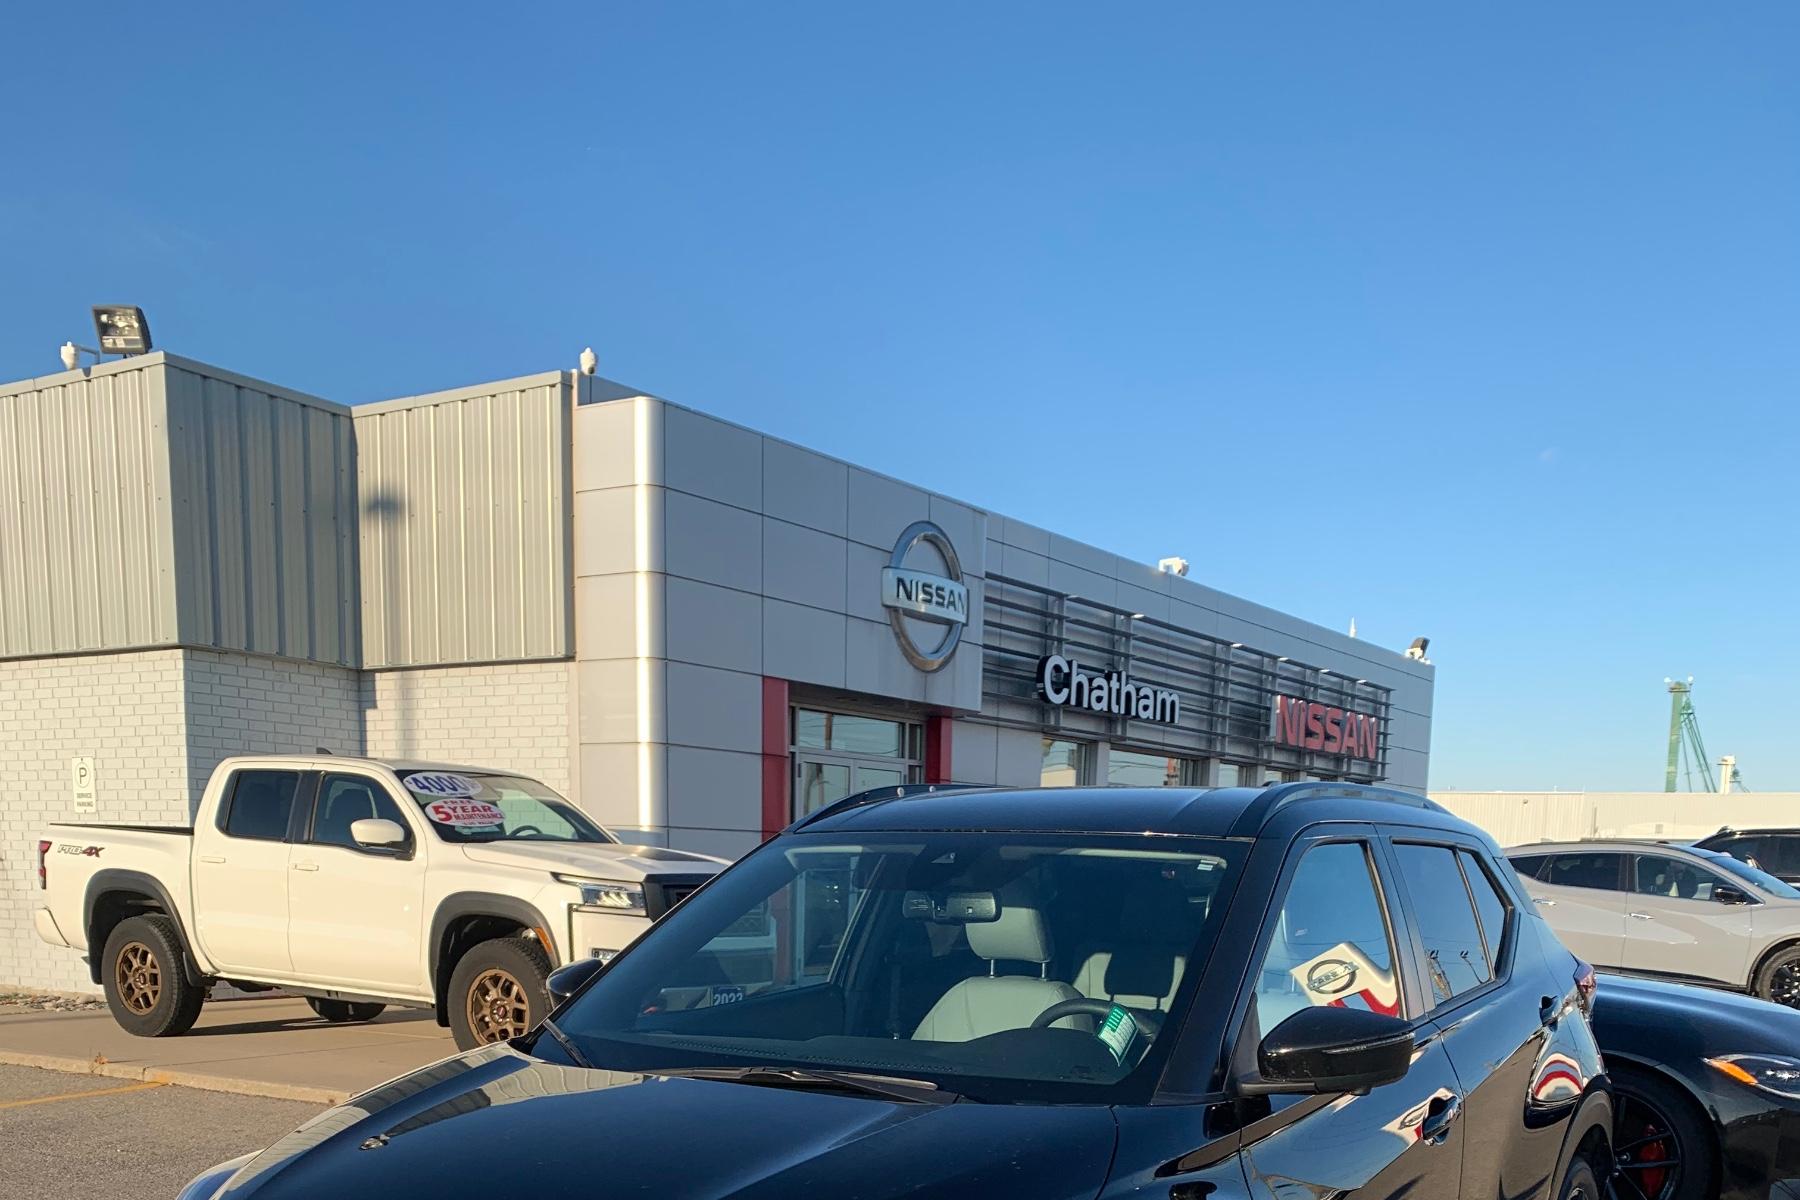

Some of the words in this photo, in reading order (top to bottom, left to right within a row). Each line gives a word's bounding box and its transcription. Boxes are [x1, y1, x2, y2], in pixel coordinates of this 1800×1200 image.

[896, 576, 965, 616] NISSAN
[1043, 654, 1180, 724] Chatham
[1274, 694, 1377, 760] NISSAN
[431, 805, 453, 822] 5
[450, 805, 494, 814] YEAR
